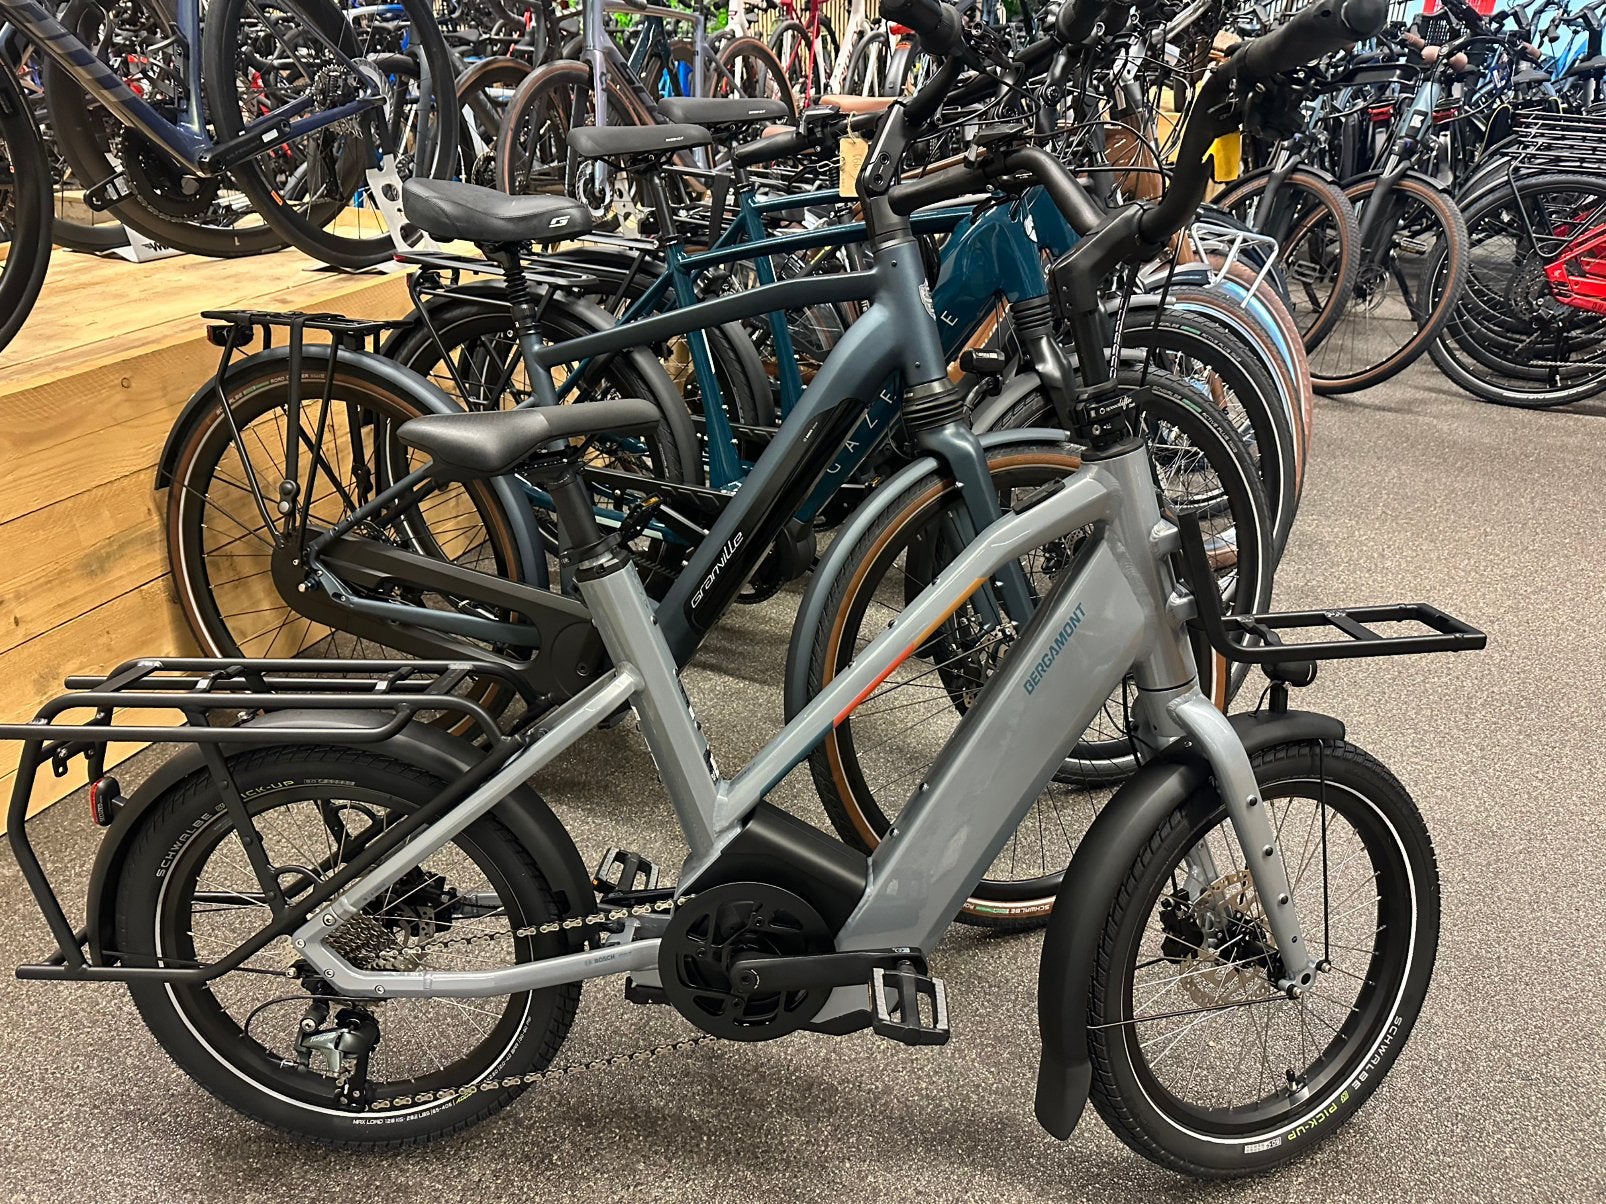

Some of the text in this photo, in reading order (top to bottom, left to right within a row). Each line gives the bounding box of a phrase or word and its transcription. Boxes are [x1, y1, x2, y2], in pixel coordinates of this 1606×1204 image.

[1023, 602, 1087, 696] BERGAMONT
[155, 779, 295, 878] SCHWALBE ICK-UP
[1010, 904, 1051, 914] SCHWALBE
[594, 954, 616, 964] BOSCH
[1287, 1016, 1403, 1141] SCHWALBE PICK-UP
